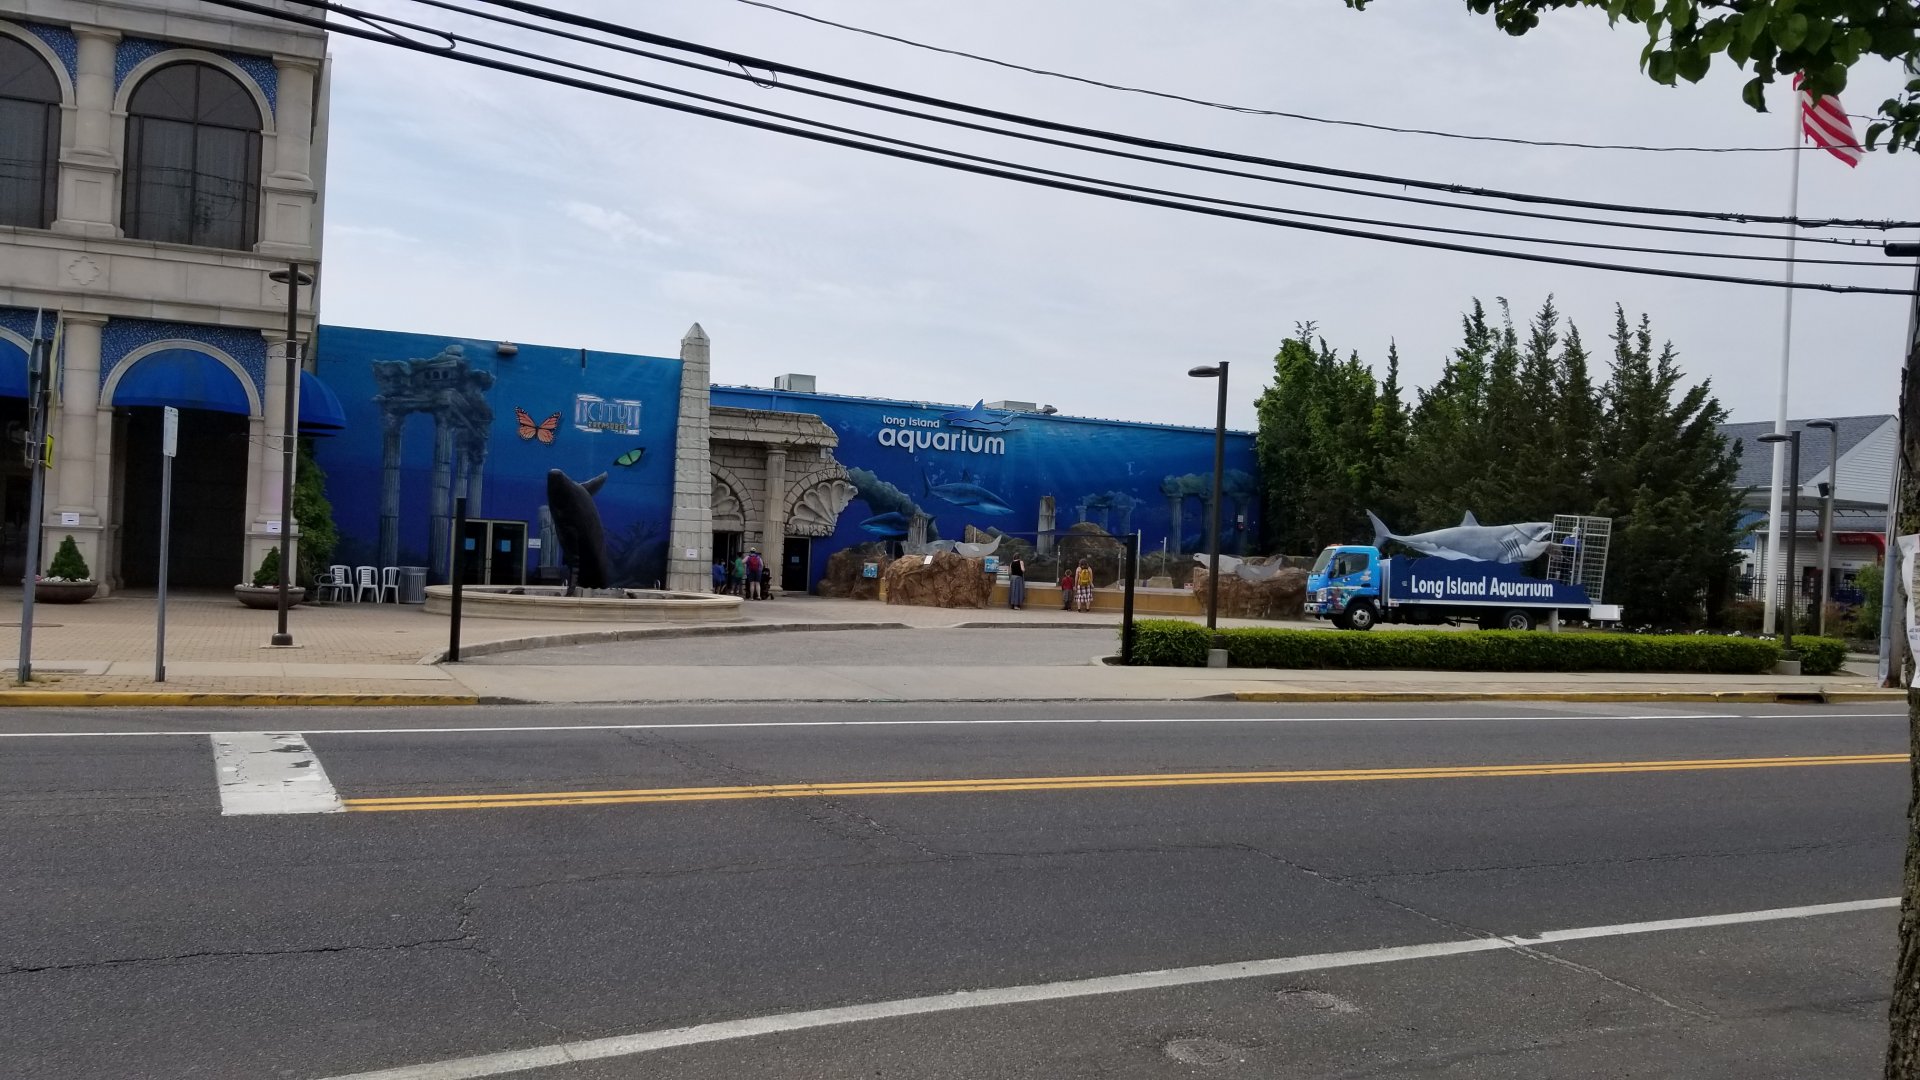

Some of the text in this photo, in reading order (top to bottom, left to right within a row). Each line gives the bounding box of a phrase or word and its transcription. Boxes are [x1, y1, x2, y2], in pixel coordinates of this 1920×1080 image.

[909, 417, 940, 428] Island
[878, 427, 1005, 455] aquarium
[1411, 575, 1553, 598] Long Island Aquarium
